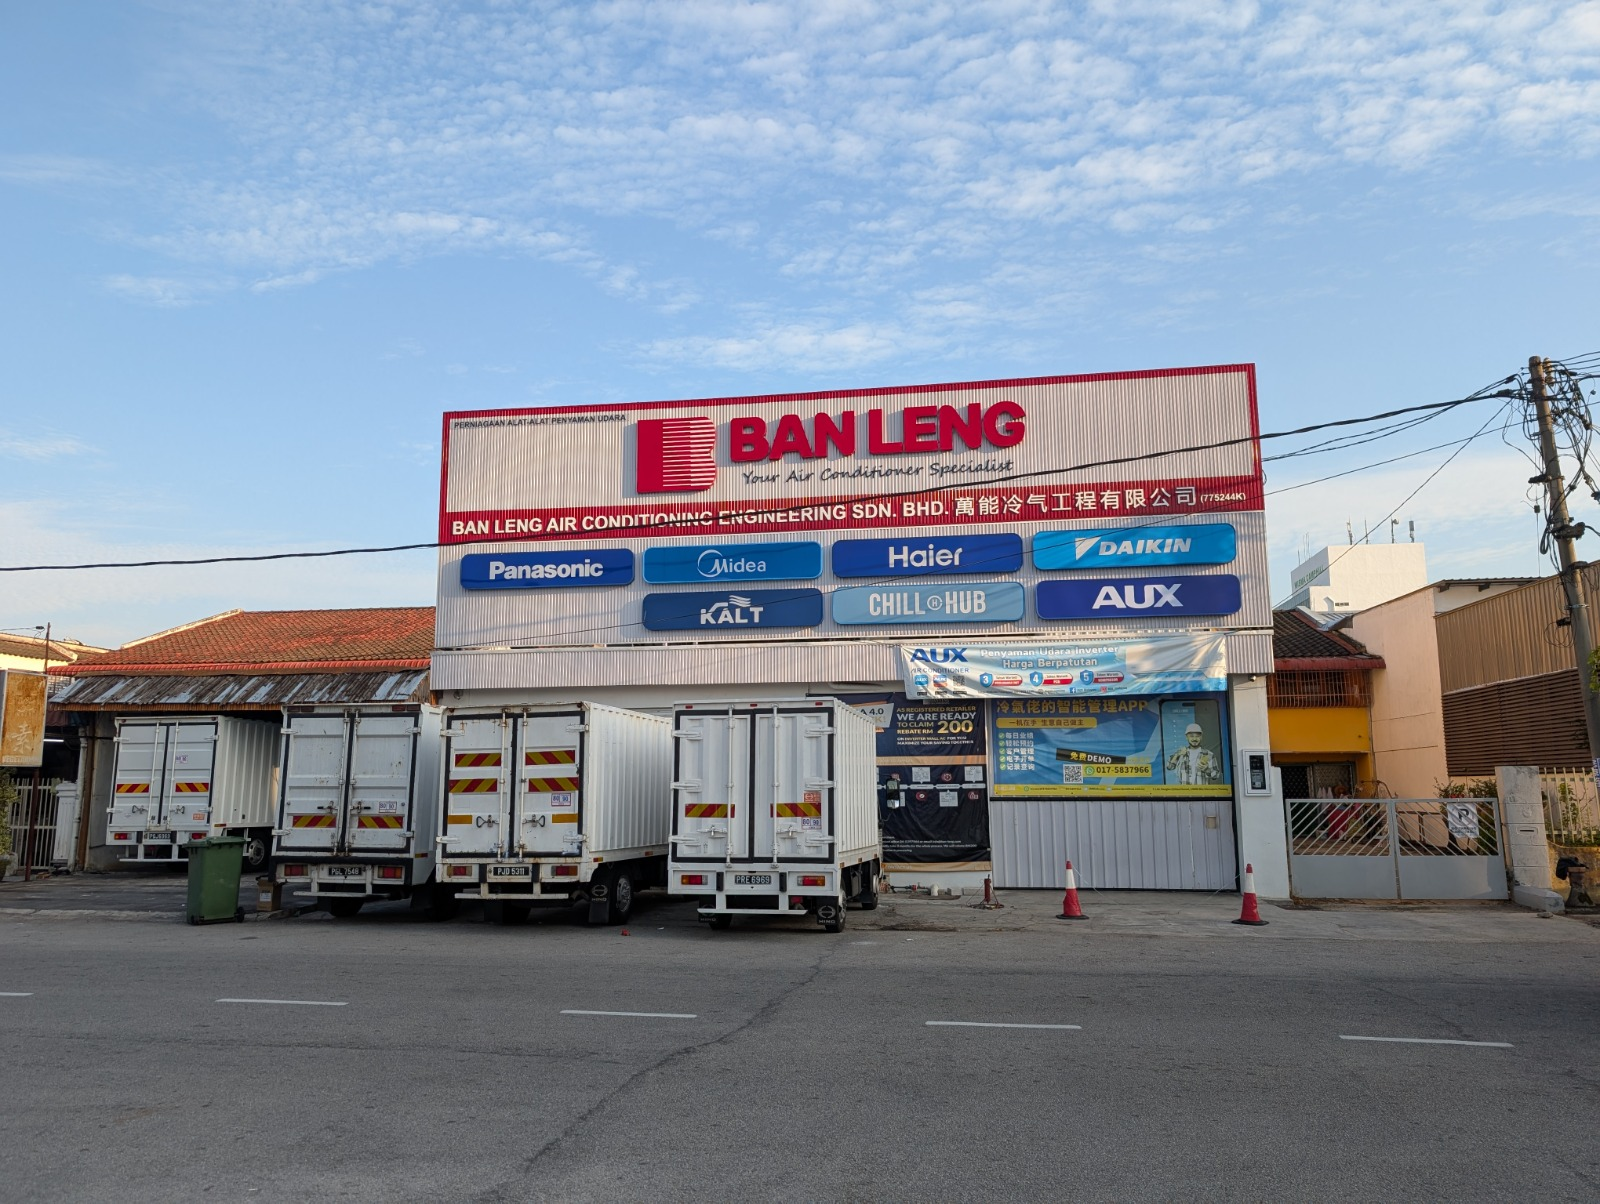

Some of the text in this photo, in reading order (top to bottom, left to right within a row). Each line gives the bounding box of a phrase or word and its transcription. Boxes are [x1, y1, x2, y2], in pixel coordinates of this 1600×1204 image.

[454, 414, 626, 429] PERNIAGAAN ALAT-ALAT PENYAMAN UDARA
[730, 400, 1027, 463] BAN LENG
[742, 458, 1015, 486] Your Air Conditioner Specialist
[955, 486, 1198, 516] 萬能冷气工程有限公司
[1200, 492, 1247, 503] (775244K)
[452, 500, 949, 536] BAN LENG AIR CONDITIONING ENGINEERING SDN. BHD.
[1098, 537, 1192, 557] DAIKIN
[888, 543, 963, 569] Haier
[489, 558, 604, 581] Panasonic
[710, 557, 767, 575] Midea
[869, 591, 925, 617] CHILL
[945, 590, 987, 615] HUB
[1092, 583, 1184, 610] AUX
[700, 604, 764, 626] KALT
[909, 647, 969, 663] AUX
[980, 648, 1035, 660] Penyaman
[1039, 646, 1071, 656] Udara
[1003, 657, 1097, 670] Harga Berpatutan
[983, 675, 989, 684] 3
[1033, 674, 1039, 683] 4
[1084, 673, 1089, 681] 5
[869, 707, 884, 715] 4.0
[897, 712, 977, 721] WE ARE READY
[937, 720, 974, 734] 200
[1096, 766, 1150, 774] 017-5837966
[345, 867, 359, 875] 7548
[511, 867, 525, 875] 5311
